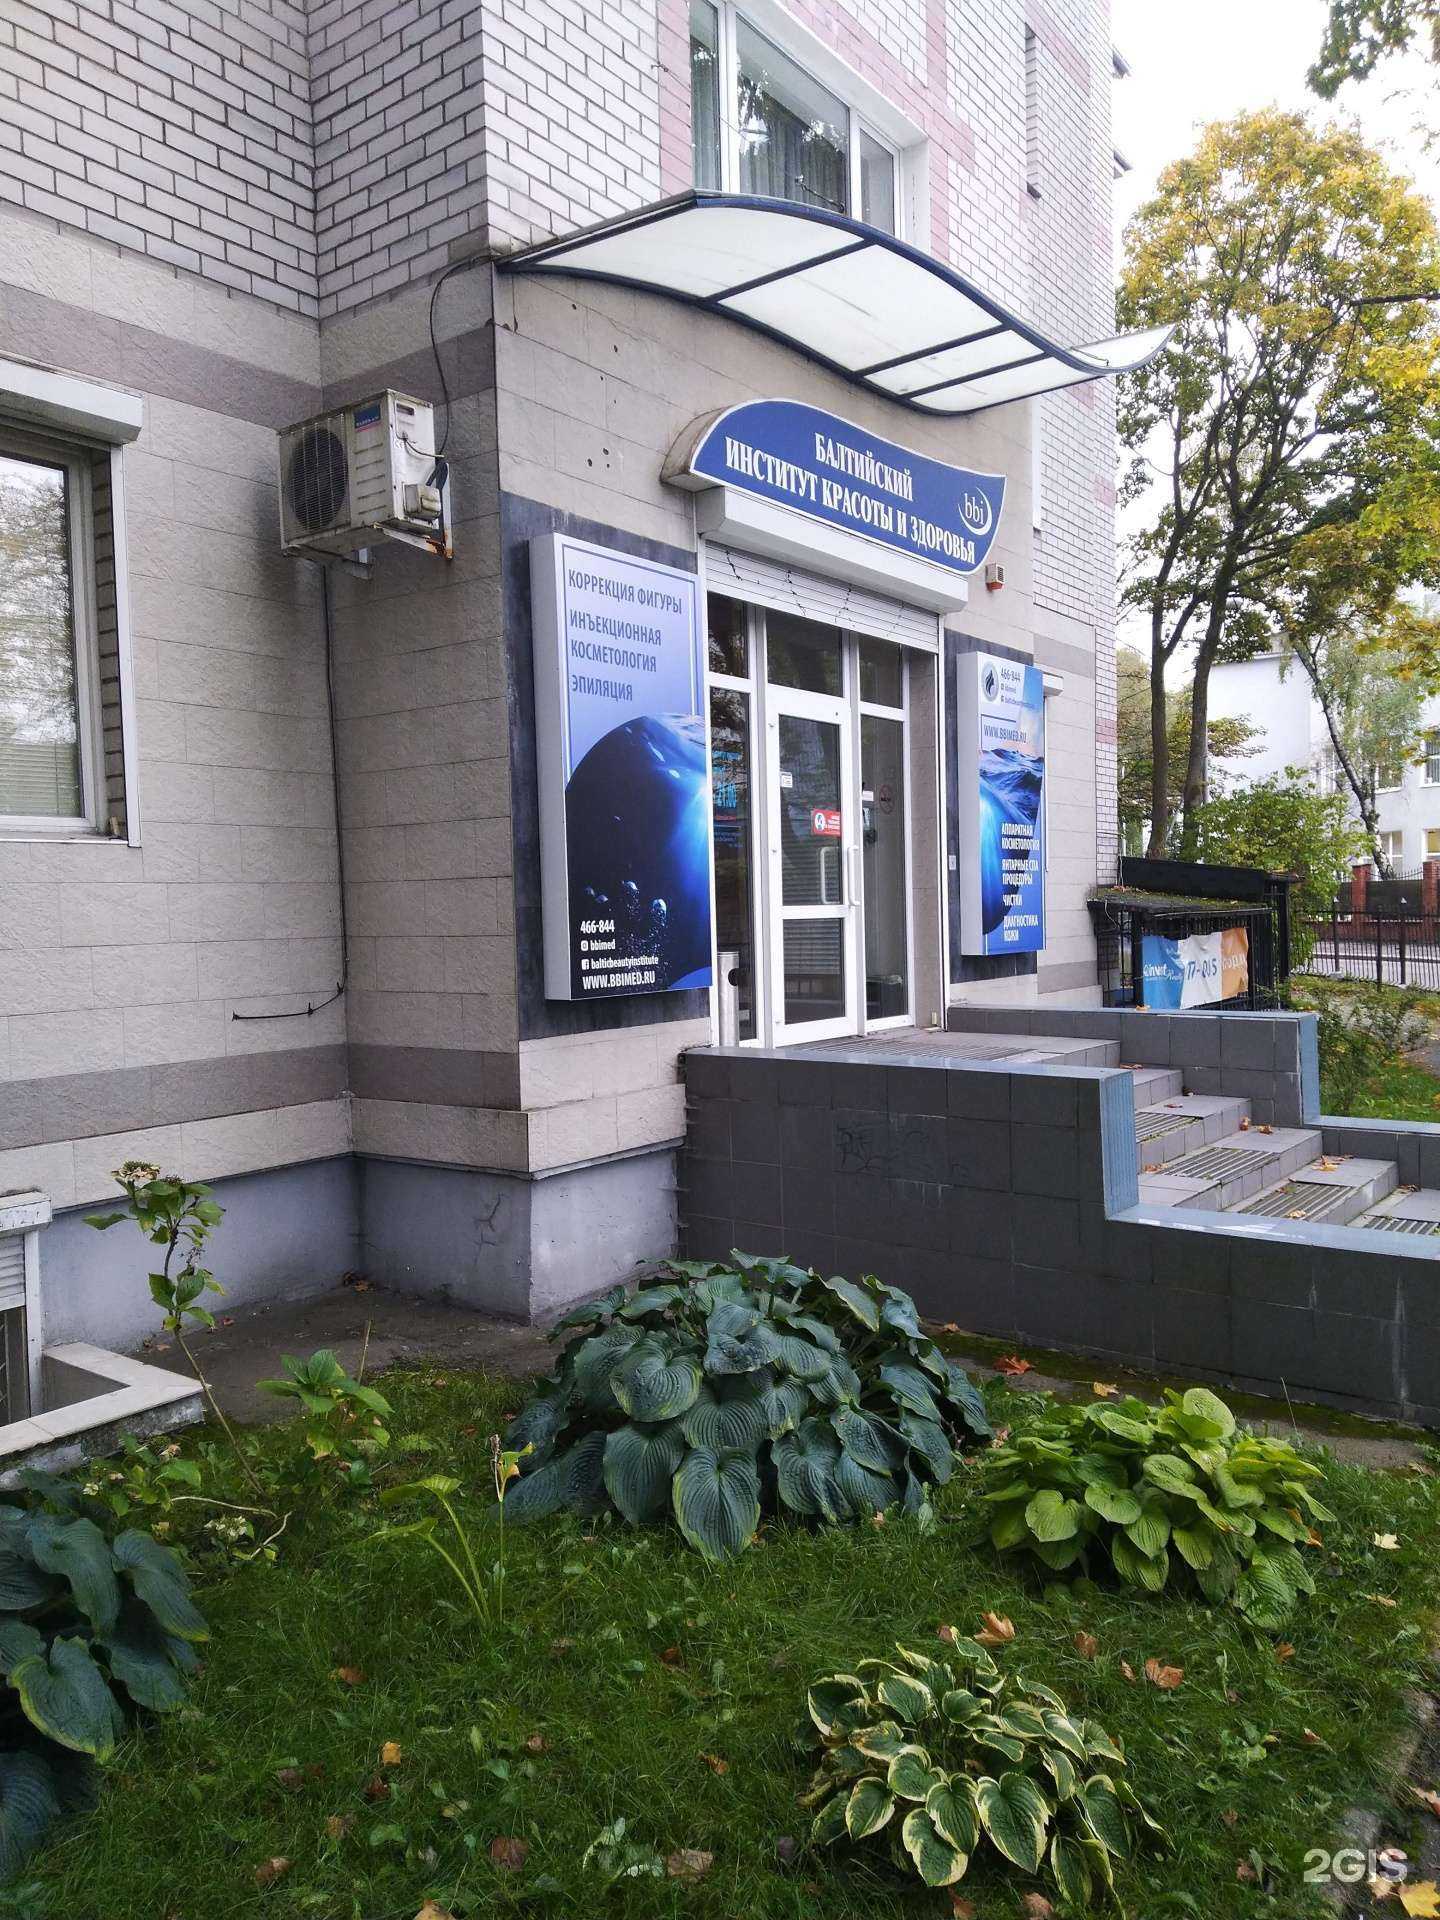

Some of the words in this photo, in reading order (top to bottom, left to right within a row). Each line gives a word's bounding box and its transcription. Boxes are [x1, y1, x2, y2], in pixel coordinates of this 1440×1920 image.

[815, 432, 913, 502] БАЛТИЙСКИЙ
[725, 436, 818, 502] ИНСТИТУТ
[822, 478, 893, 530] КРАСОТЫ
[896, 509, 907, 537] И
[910, 515, 976, 565] ЗДОРОВЬЯ
[964, 492, 984, 526] bbi
[568, 568, 635, 603] КОРРЕКЦИЯ
[637, 587, 682, 614] ФИГУРЫ
[569, 609, 662, 646] ИНЪЕКЦИОННАЯ
[571, 639, 657, 672] КОСМЕТОЛОГИЯ
[572, 674, 633, 702] ЭПИЛЯЦИЯ
[580, 919, 615, 934] 466-844
[590, 938, 616, 951] bbimed
[591, 955, 659, 970] balticbeautyinstitute
[582, 970, 656, 990] WWW.BBIMED.RU
